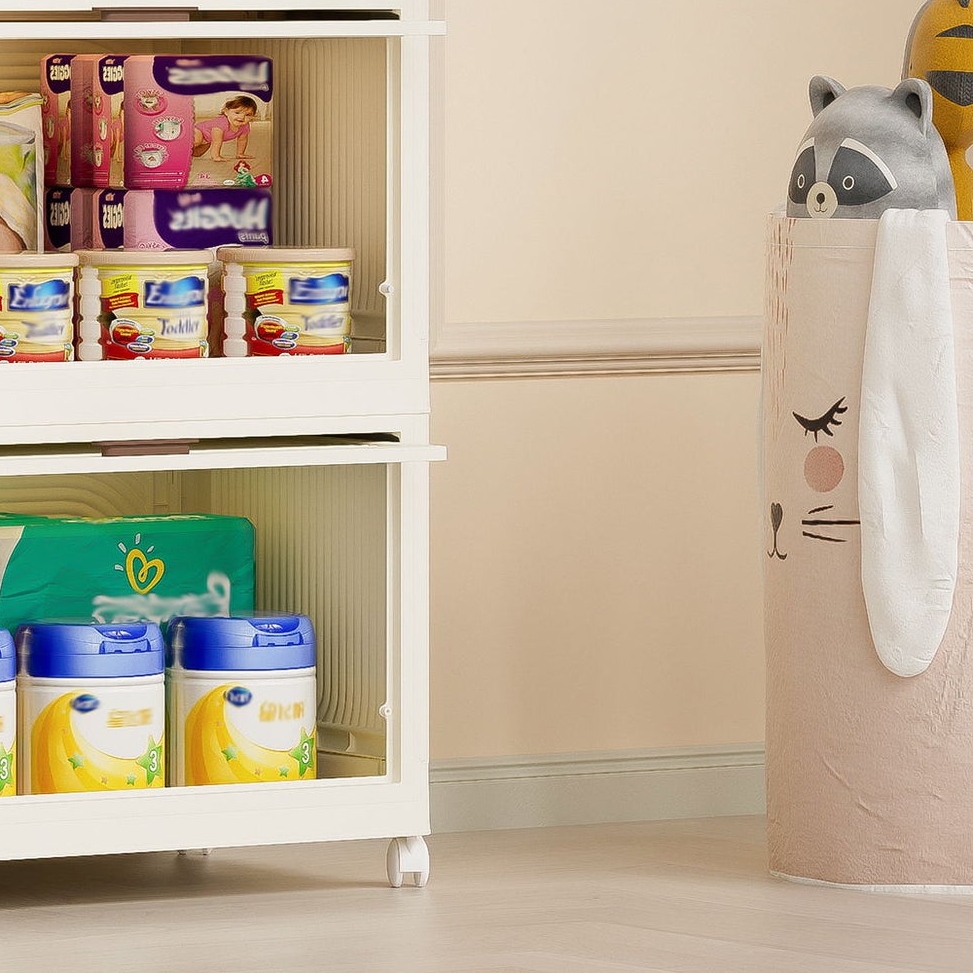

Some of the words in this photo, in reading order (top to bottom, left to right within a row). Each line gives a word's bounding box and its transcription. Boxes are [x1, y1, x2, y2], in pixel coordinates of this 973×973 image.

[157, 316, 200, 336] Toddler
[149, 751, 158, 772] 3
[301, 742, 310, 764] 3
[0, 757, 8, 780] 3
